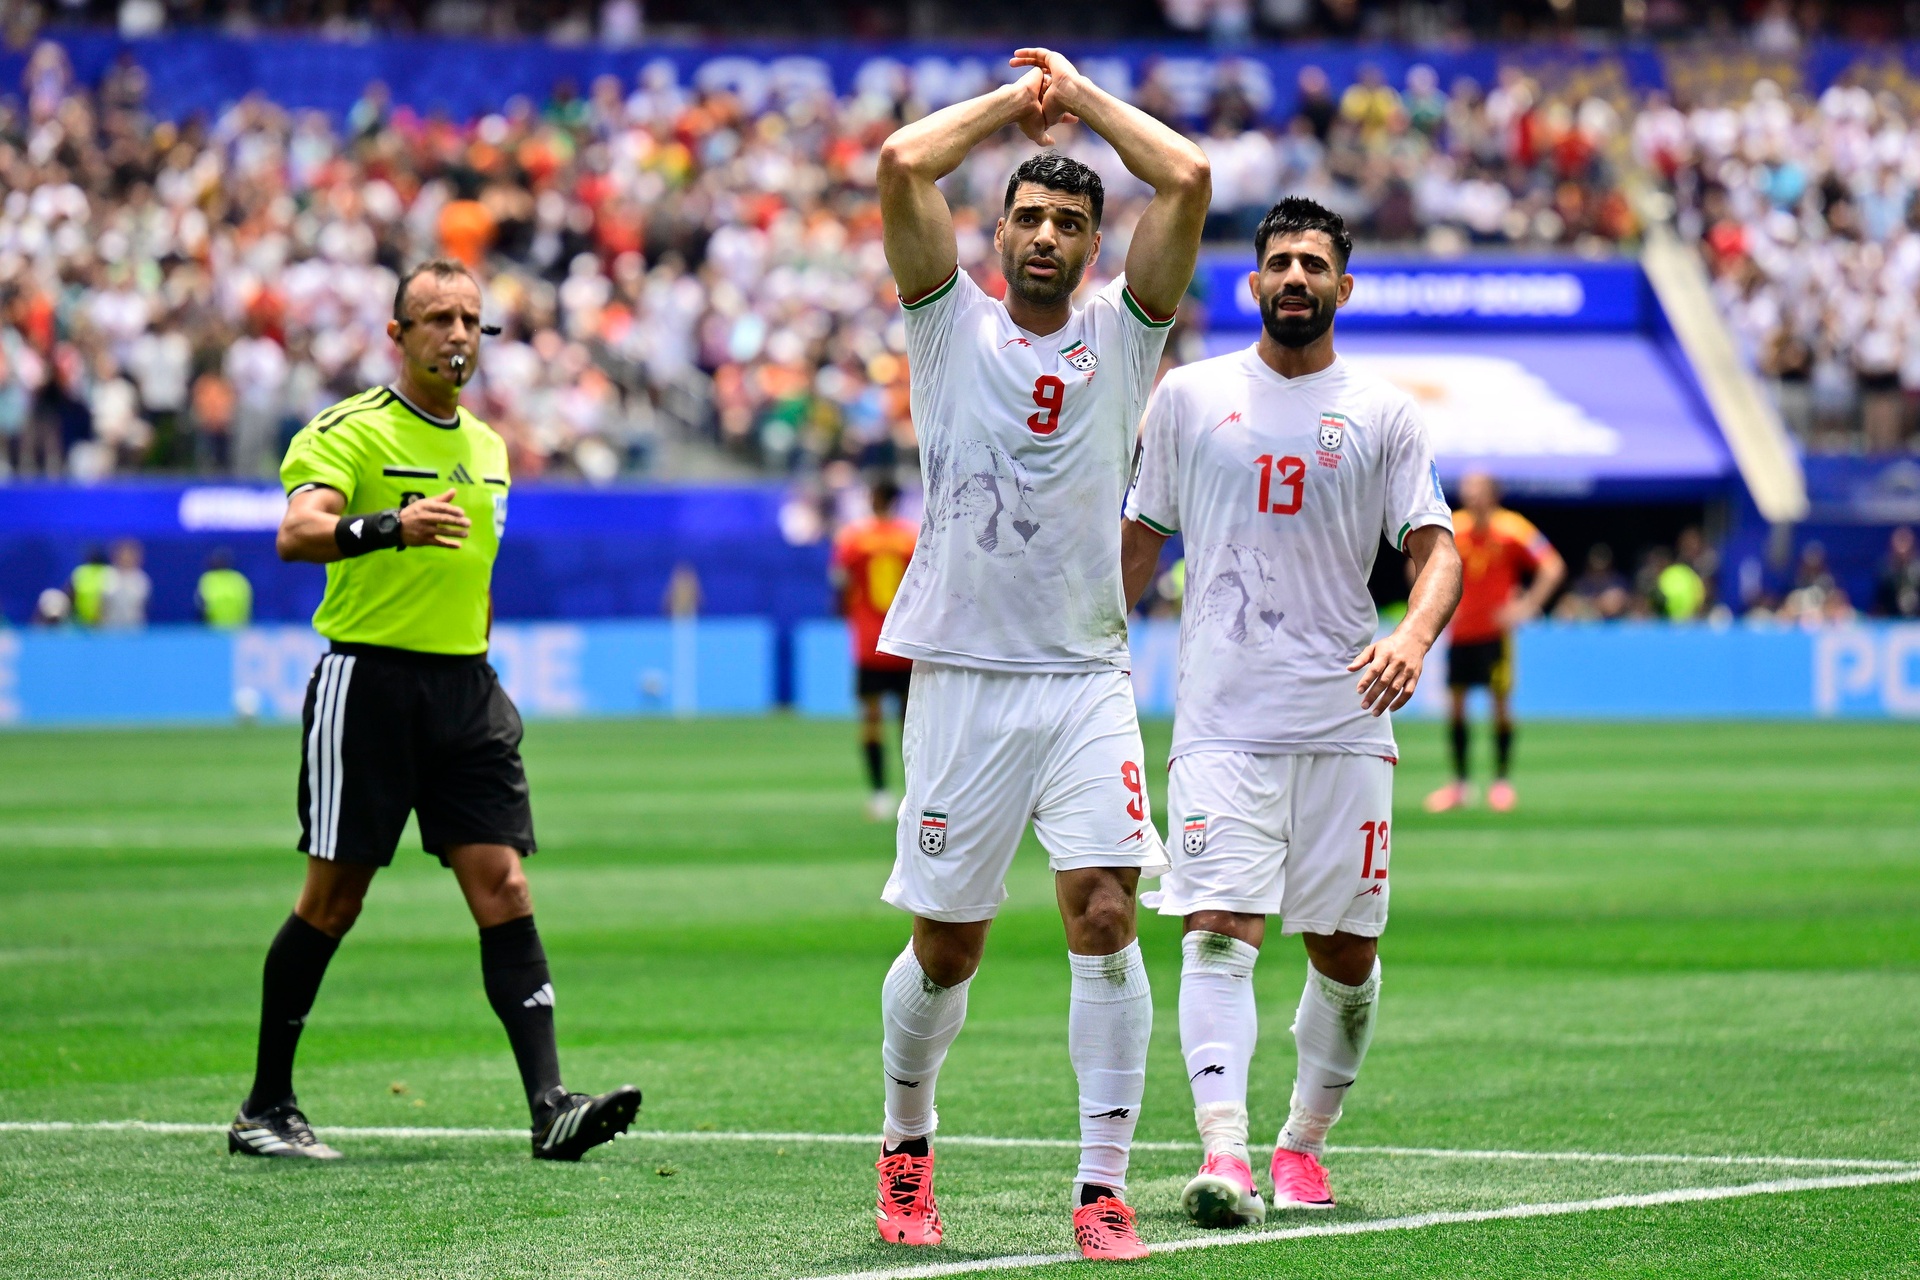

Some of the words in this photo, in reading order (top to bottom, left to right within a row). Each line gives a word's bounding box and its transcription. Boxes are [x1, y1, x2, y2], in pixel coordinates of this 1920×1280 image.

[1027, 374, 1066, 435] 9
[1254, 454, 1305, 516] 13
[1120, 760, 1144, 821] 9
[1359, 820, 1389, 880] 13
